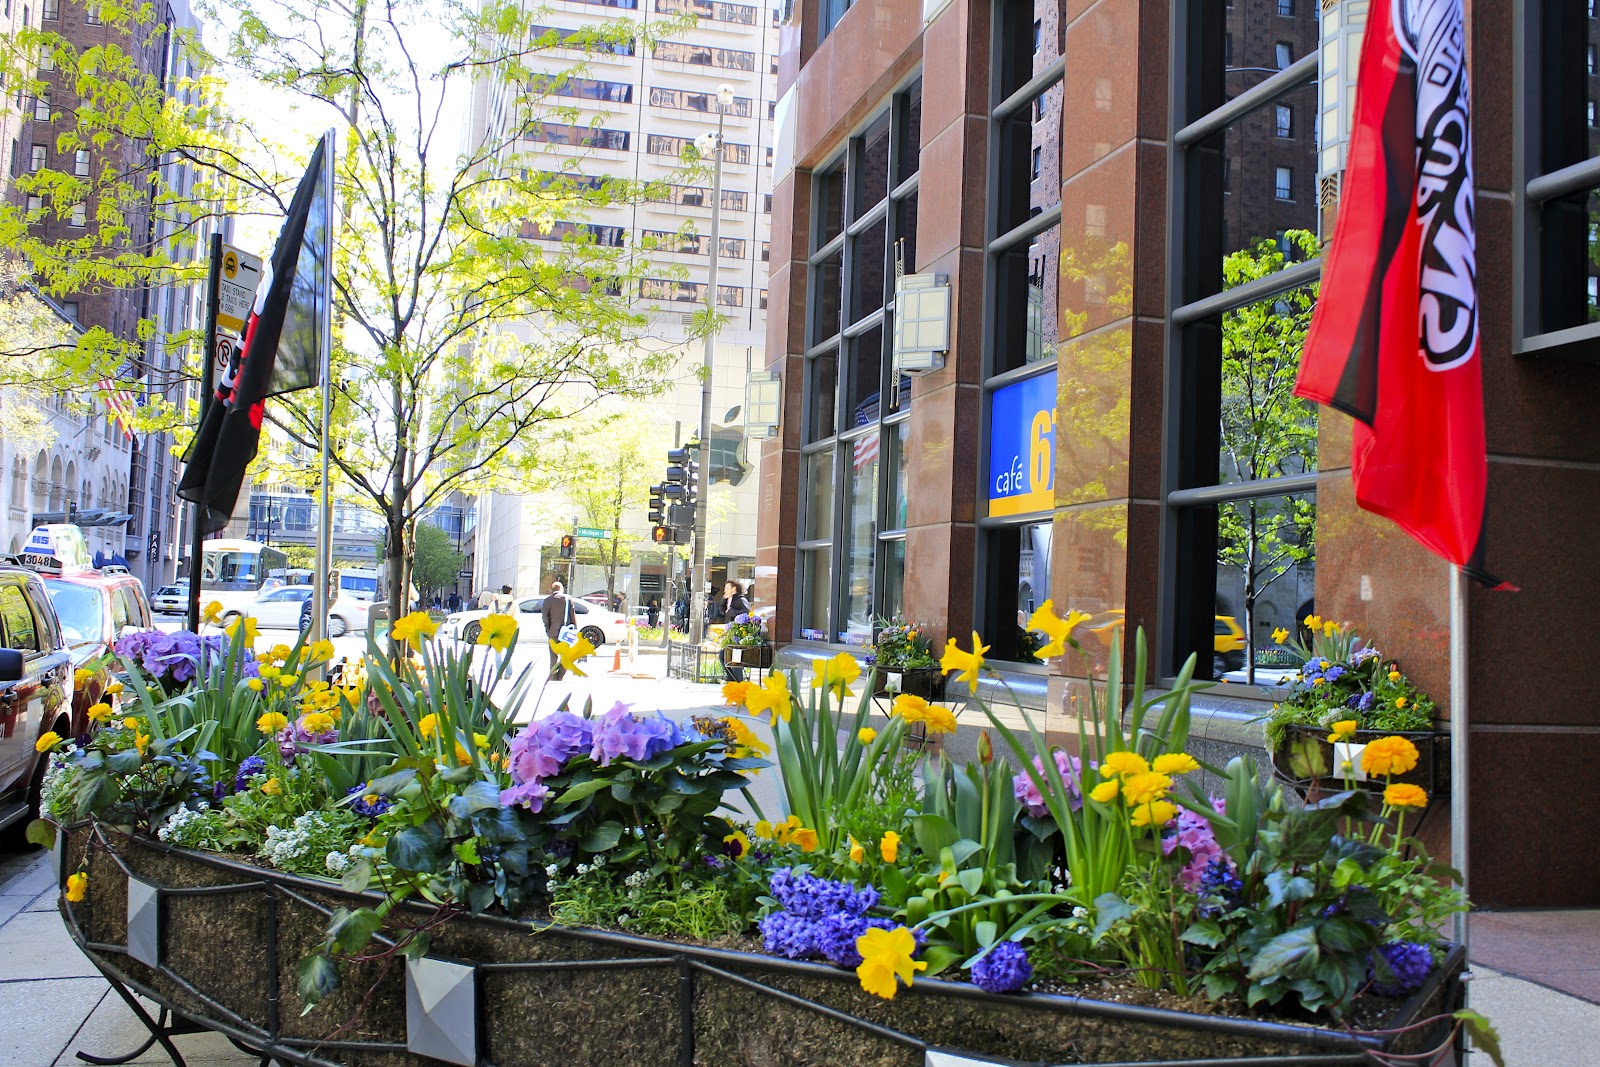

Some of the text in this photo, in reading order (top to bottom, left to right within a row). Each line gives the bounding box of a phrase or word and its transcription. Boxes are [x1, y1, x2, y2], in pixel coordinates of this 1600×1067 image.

[222, 283, 246, 298] TAXI STAND
[221, 292, 250, 310] 2 TAXIS HERE
[225, 304, 234, 313] 599
[996, 455, 1023, 495] café
[581, 529, 600, 537] Michigan
[25, 554, 50, 567] 3048
